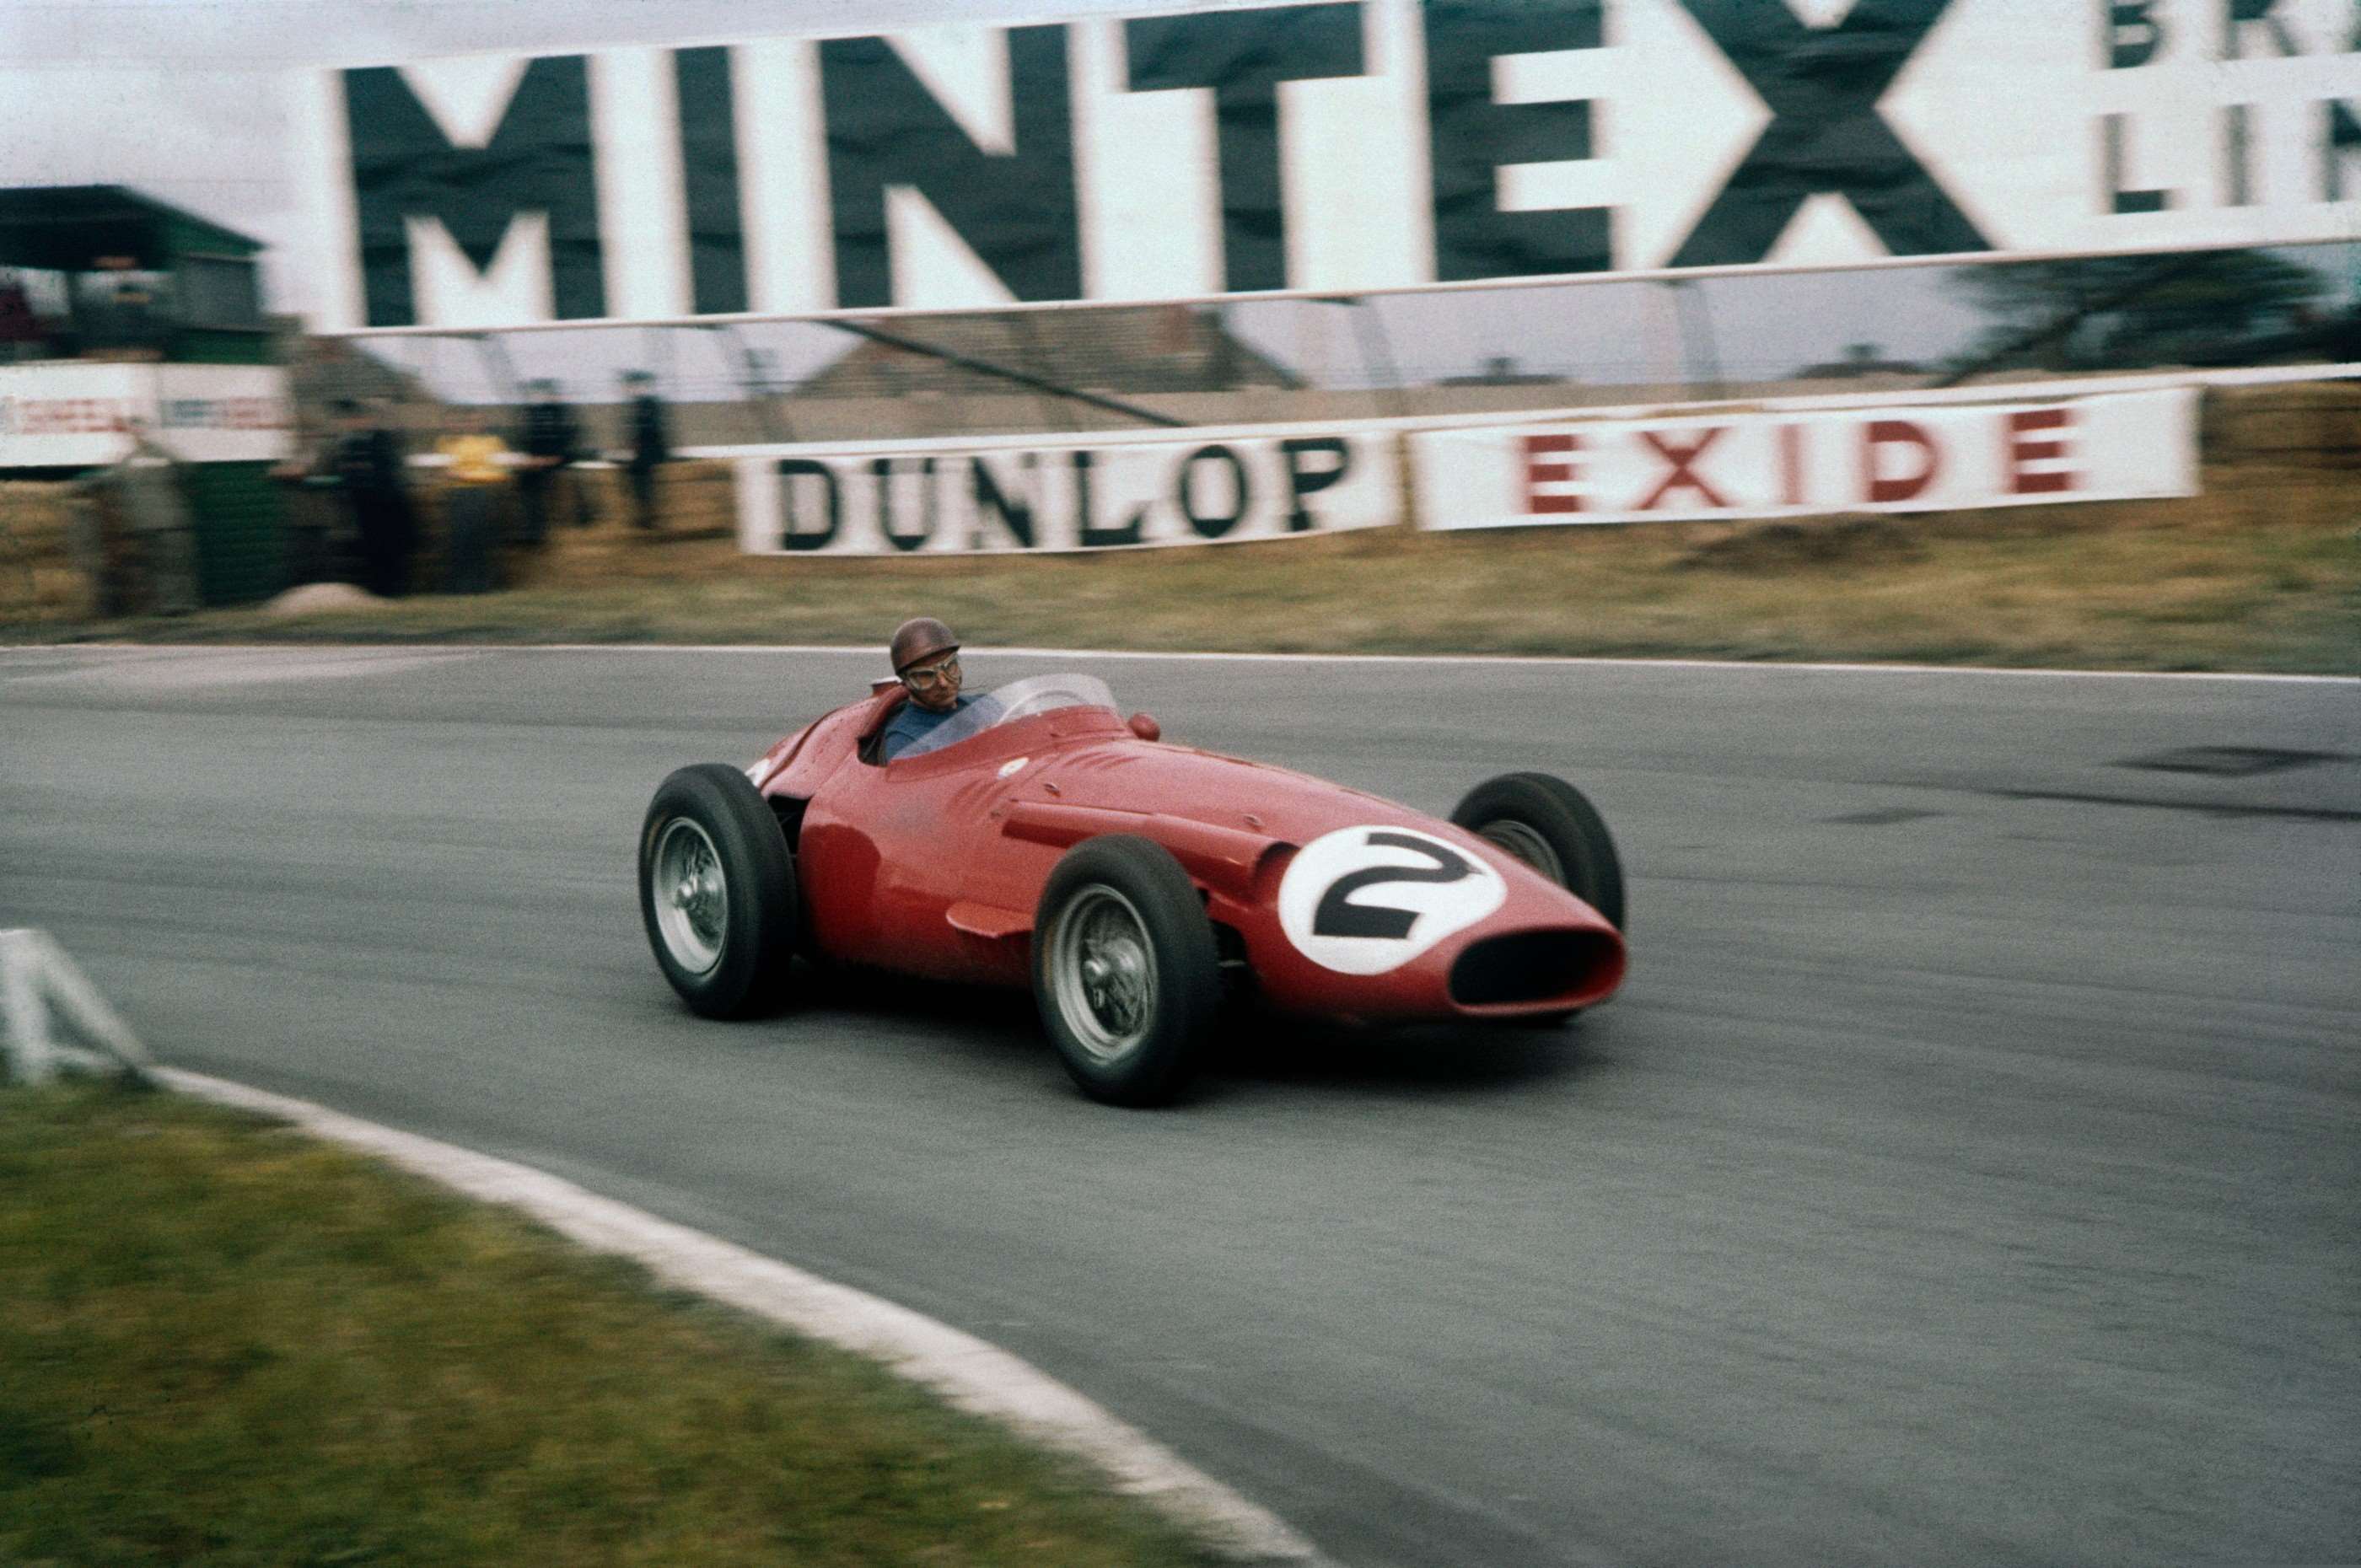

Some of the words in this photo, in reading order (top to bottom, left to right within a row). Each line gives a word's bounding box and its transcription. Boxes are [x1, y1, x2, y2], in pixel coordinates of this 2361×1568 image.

[2098, 0, 2361, 70] BR
[339, 0, 2000, 329] MINTEX
[774, 435, 1353, 553] DUNLOP
[1521, 407, 2079, 516] EXIDE
[1312, 831, 1487, 940] 2
